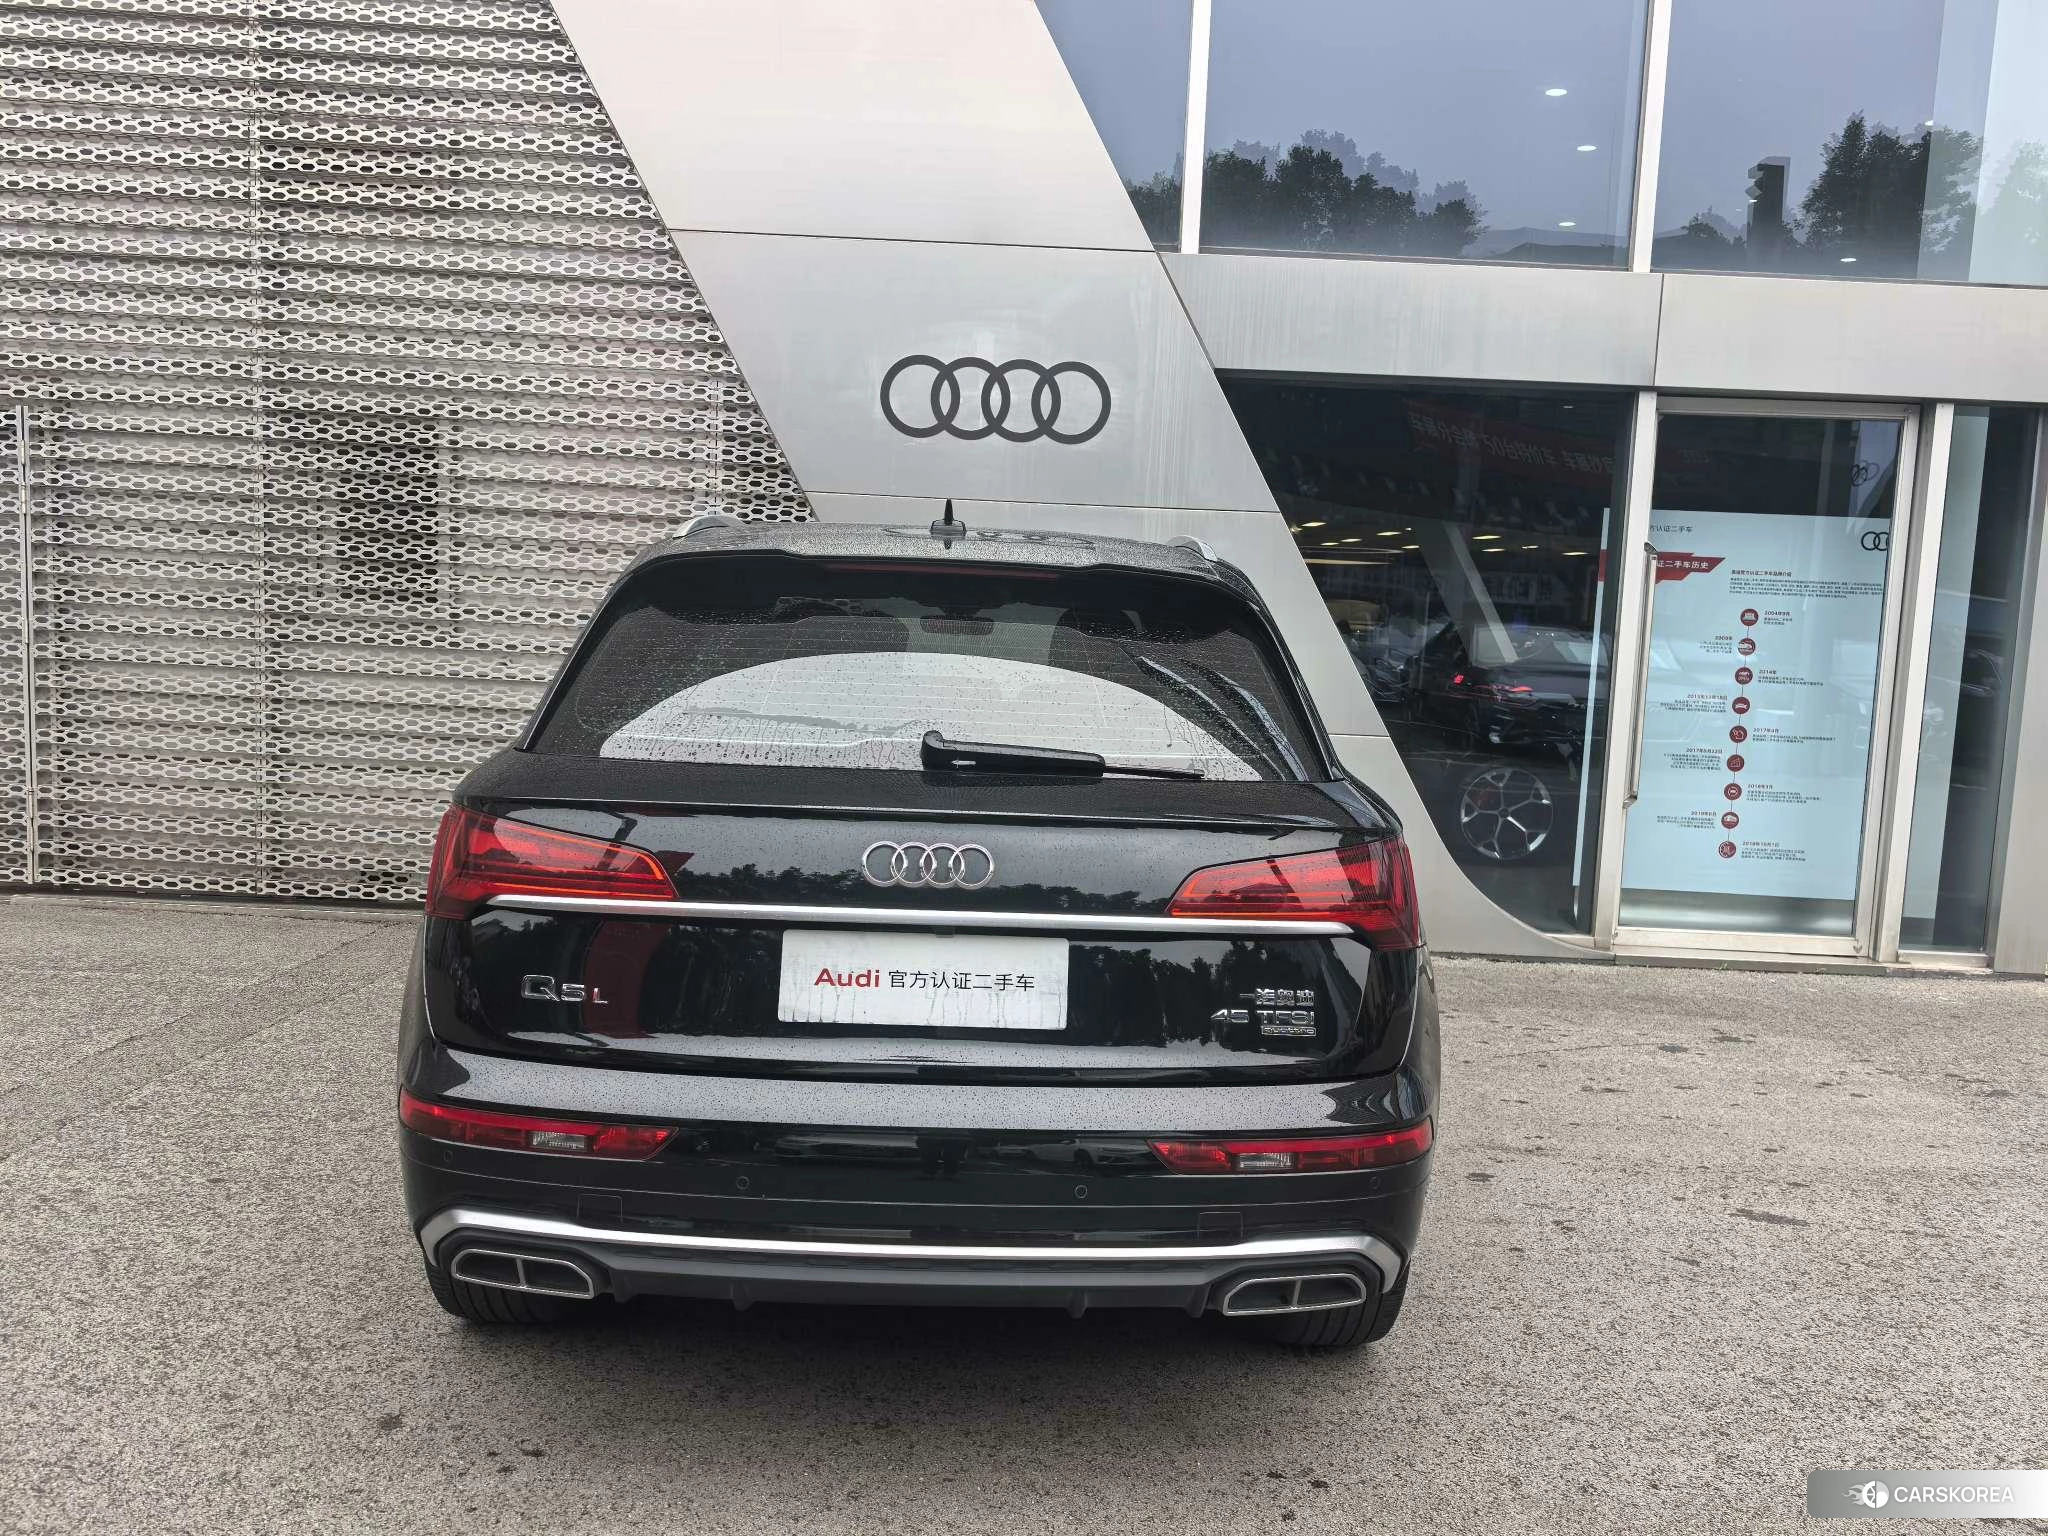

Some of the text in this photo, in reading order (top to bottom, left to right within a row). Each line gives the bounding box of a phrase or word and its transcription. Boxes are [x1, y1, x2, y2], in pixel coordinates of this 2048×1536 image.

[521, 974, 609, 1004] Q5 L
[814, 968, 1036, 992] Audi 官方认证二手车
[1210, 1008, 1315, 1025] 45 TFSI
